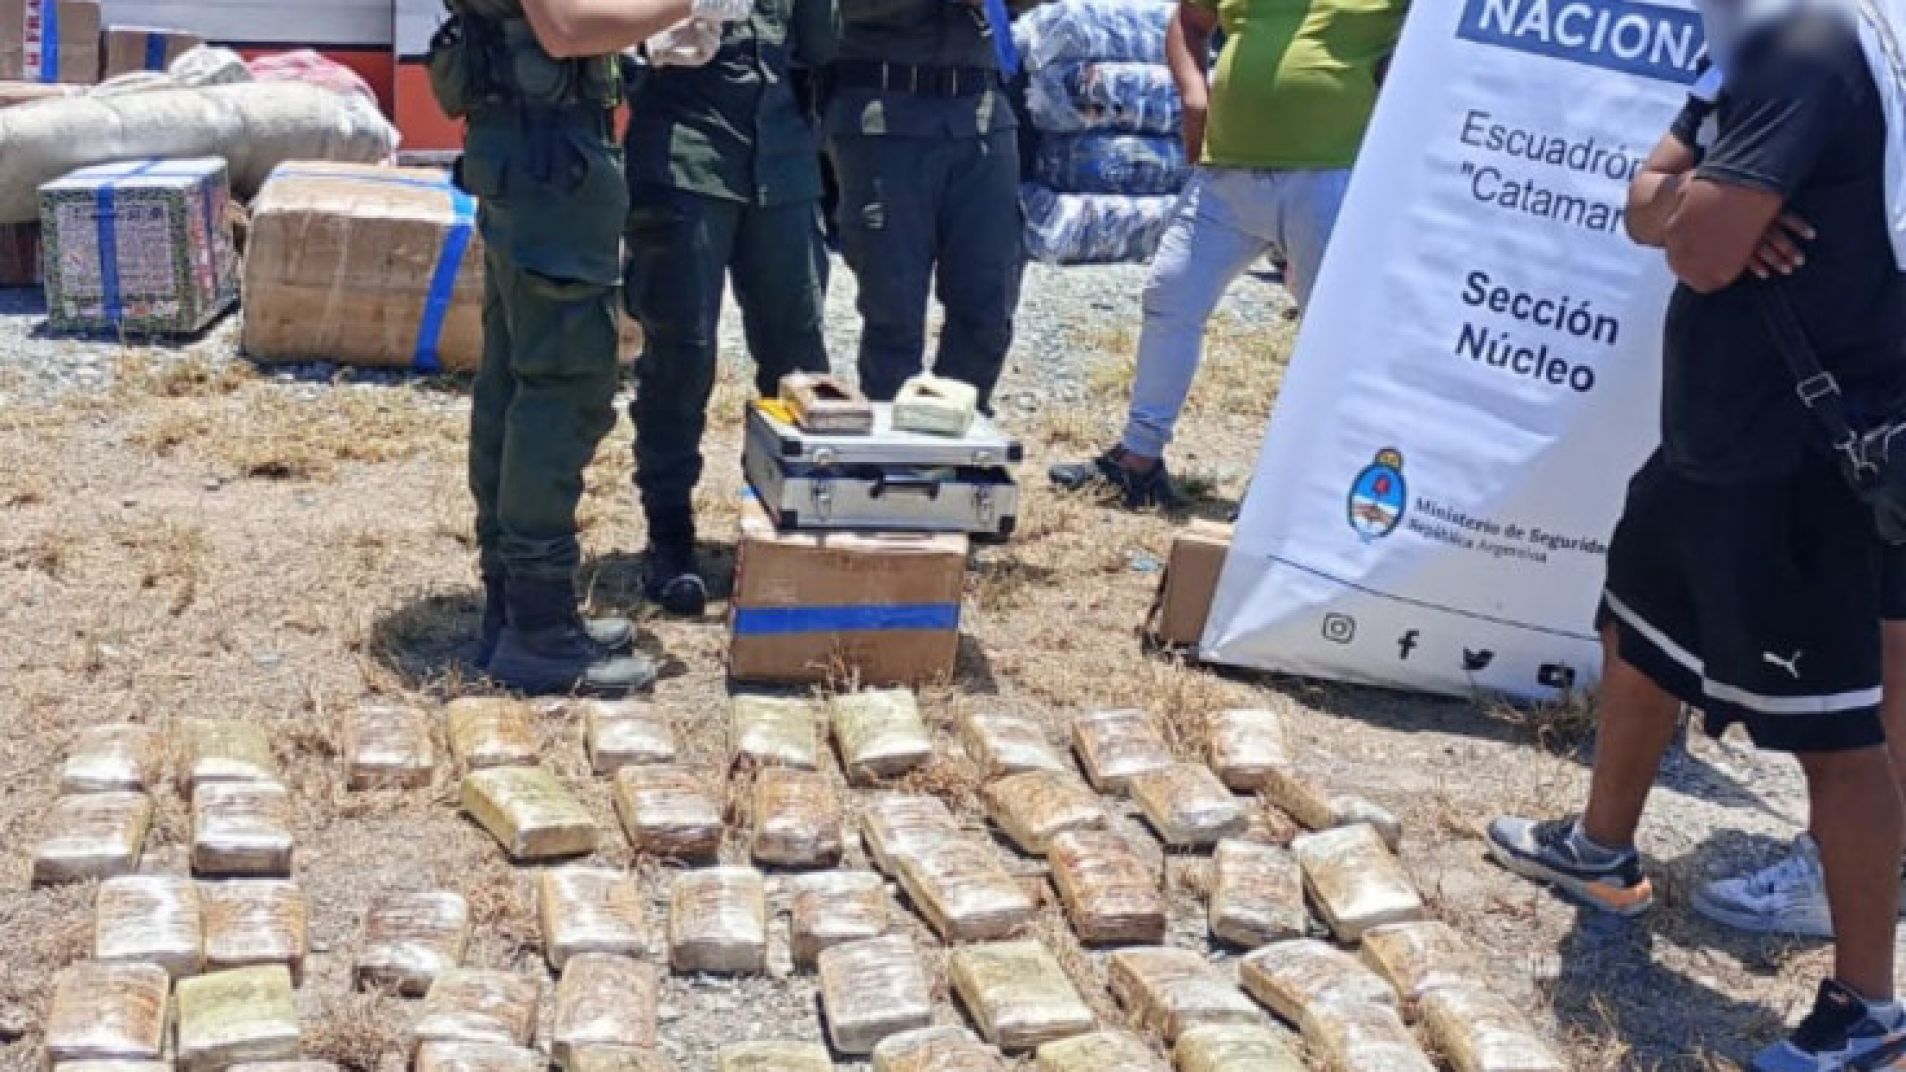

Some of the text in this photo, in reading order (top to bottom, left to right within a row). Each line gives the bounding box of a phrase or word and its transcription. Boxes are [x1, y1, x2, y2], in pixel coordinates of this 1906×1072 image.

[1462, 270, 1619, 346] Sección
[1455, 321, 1596, 393] Núcleo
[1408, 517, 1547, 564] República Argentina
[1416, 496, 1501, 535] Ministerio
[1504, 524, 1525, 539] de
